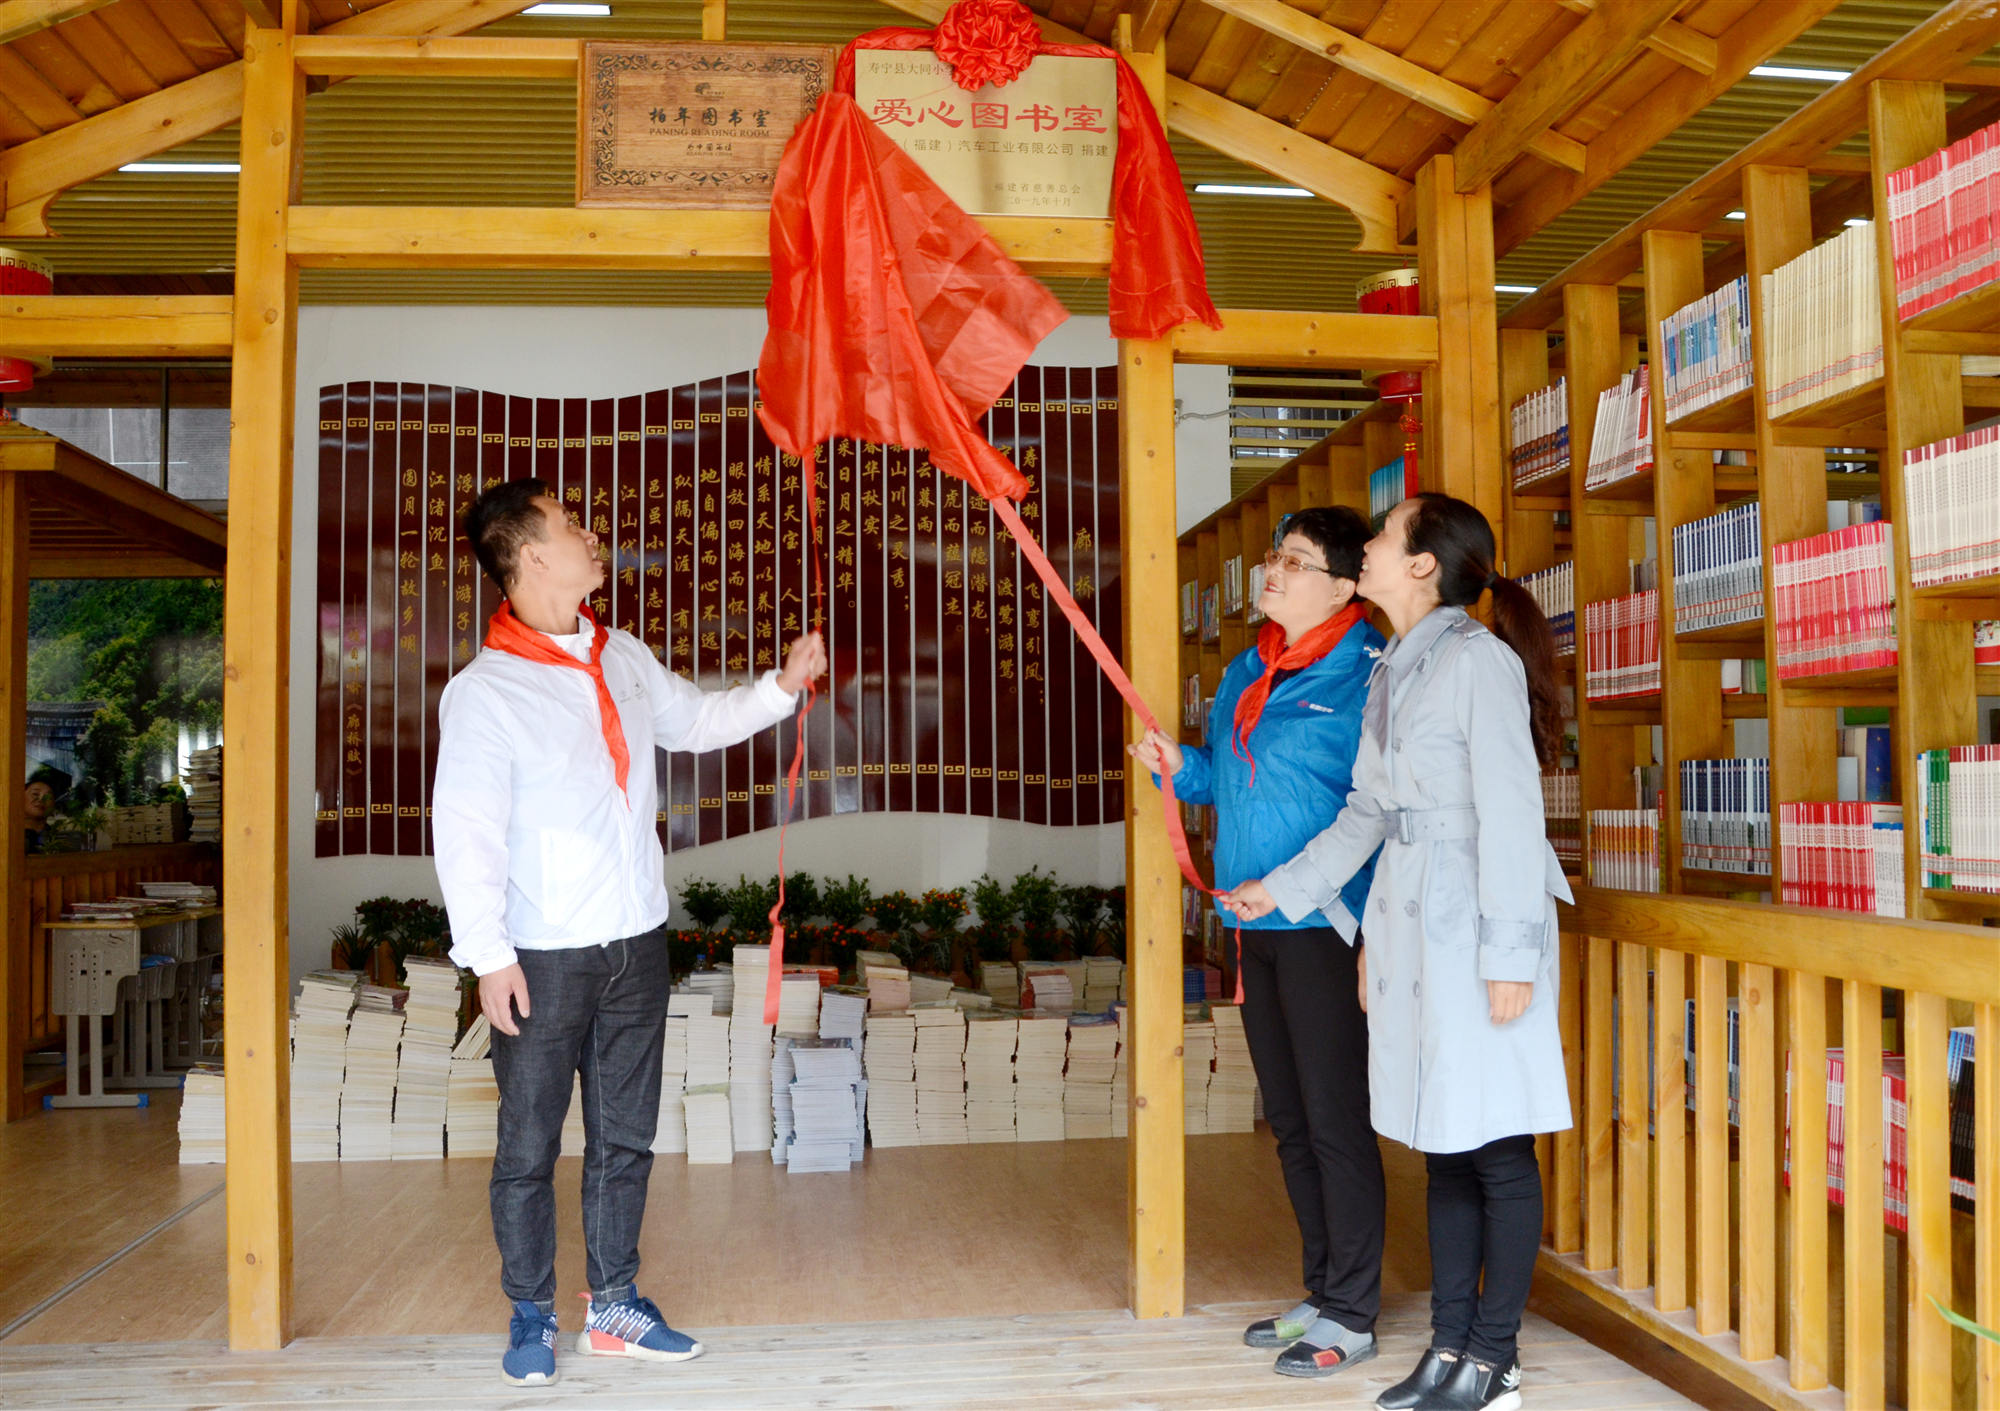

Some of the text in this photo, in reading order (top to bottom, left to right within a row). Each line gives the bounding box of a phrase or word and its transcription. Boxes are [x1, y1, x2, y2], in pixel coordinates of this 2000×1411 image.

[872, 98, 1108, 134] 爱心图书室
[893, 139, 1074, 156] （福建）汽车工业有限公司
[916, 447, 937, 548] 云暮雨，
[1074, 527, 1095, 642] 廊桥
